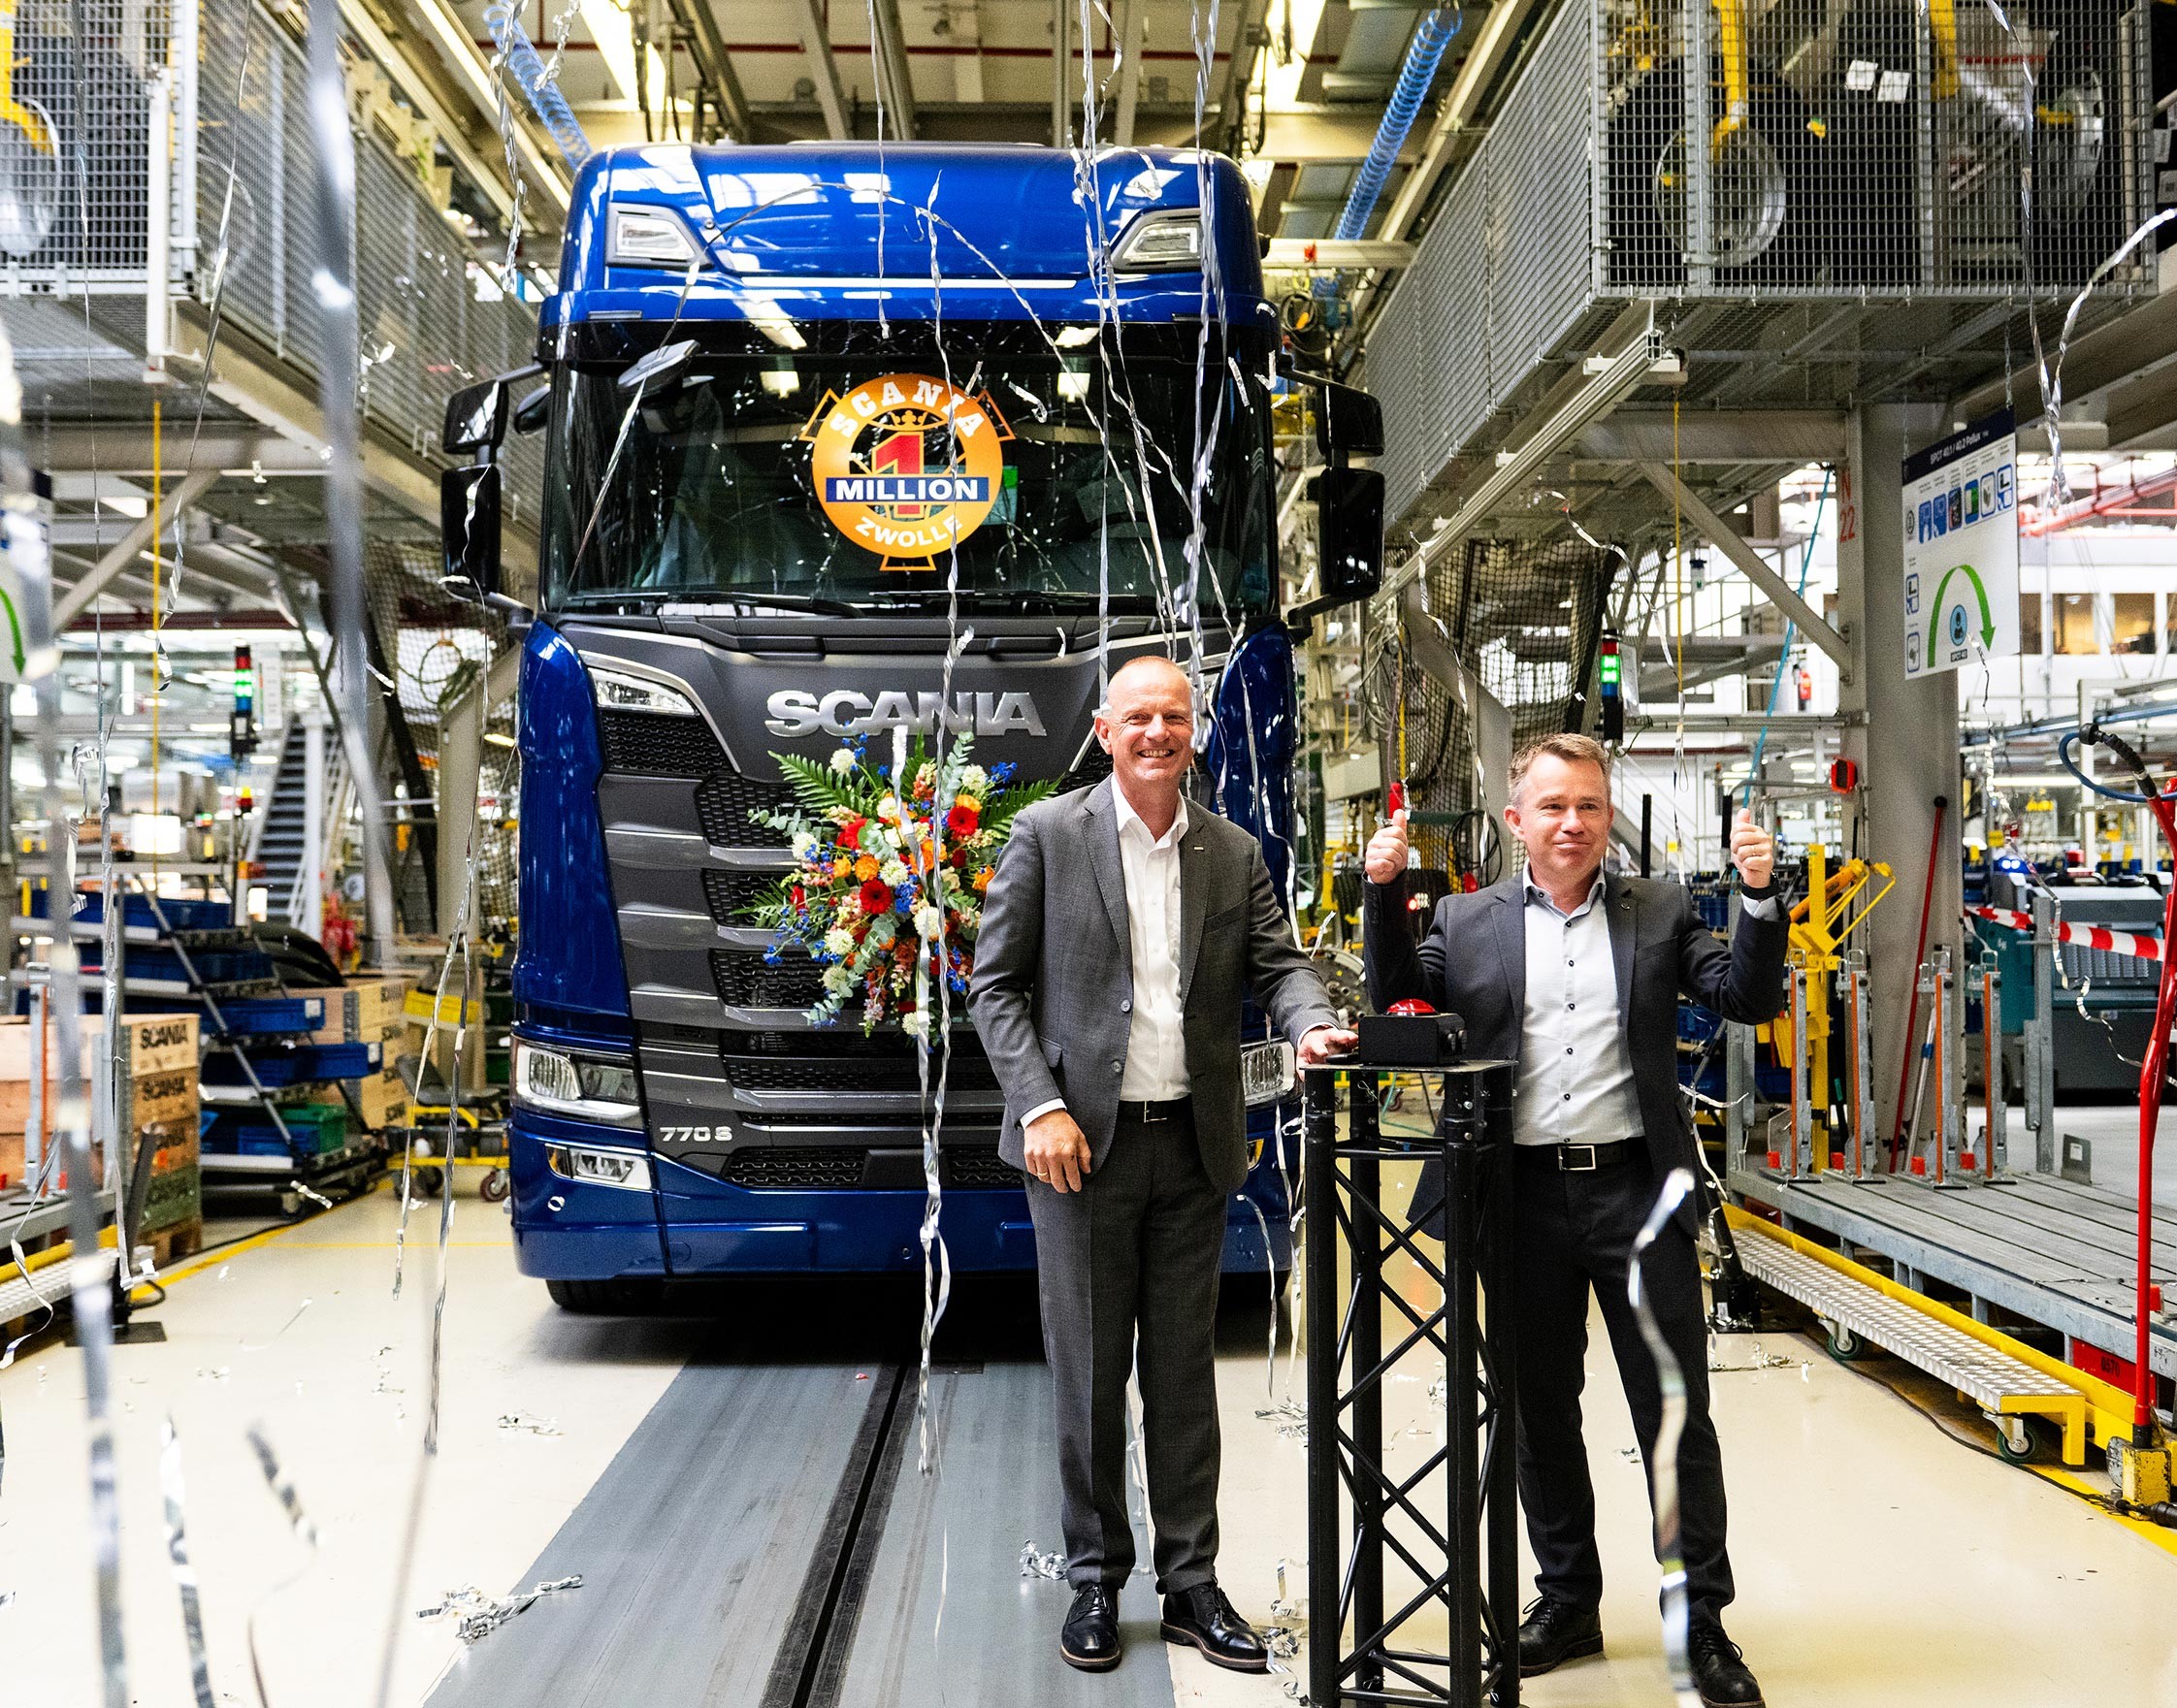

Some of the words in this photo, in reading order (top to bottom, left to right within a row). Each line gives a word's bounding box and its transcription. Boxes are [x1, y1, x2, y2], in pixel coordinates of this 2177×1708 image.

[829, 379, 986, 438] SCANIA
[835, 479, 978, 501] MILLION
[875, 434, 922, 516] 1
[855, 515, 963, 548] ZWOLLE
[1839, 504, 1855, 542] 22
[764, 690, 1048, 737] SCANIA
[140, 1023, 188, 1049] SCANIA
[659, 1126, 712, 1143] 770
[714, 1126, 733, 1143] S
